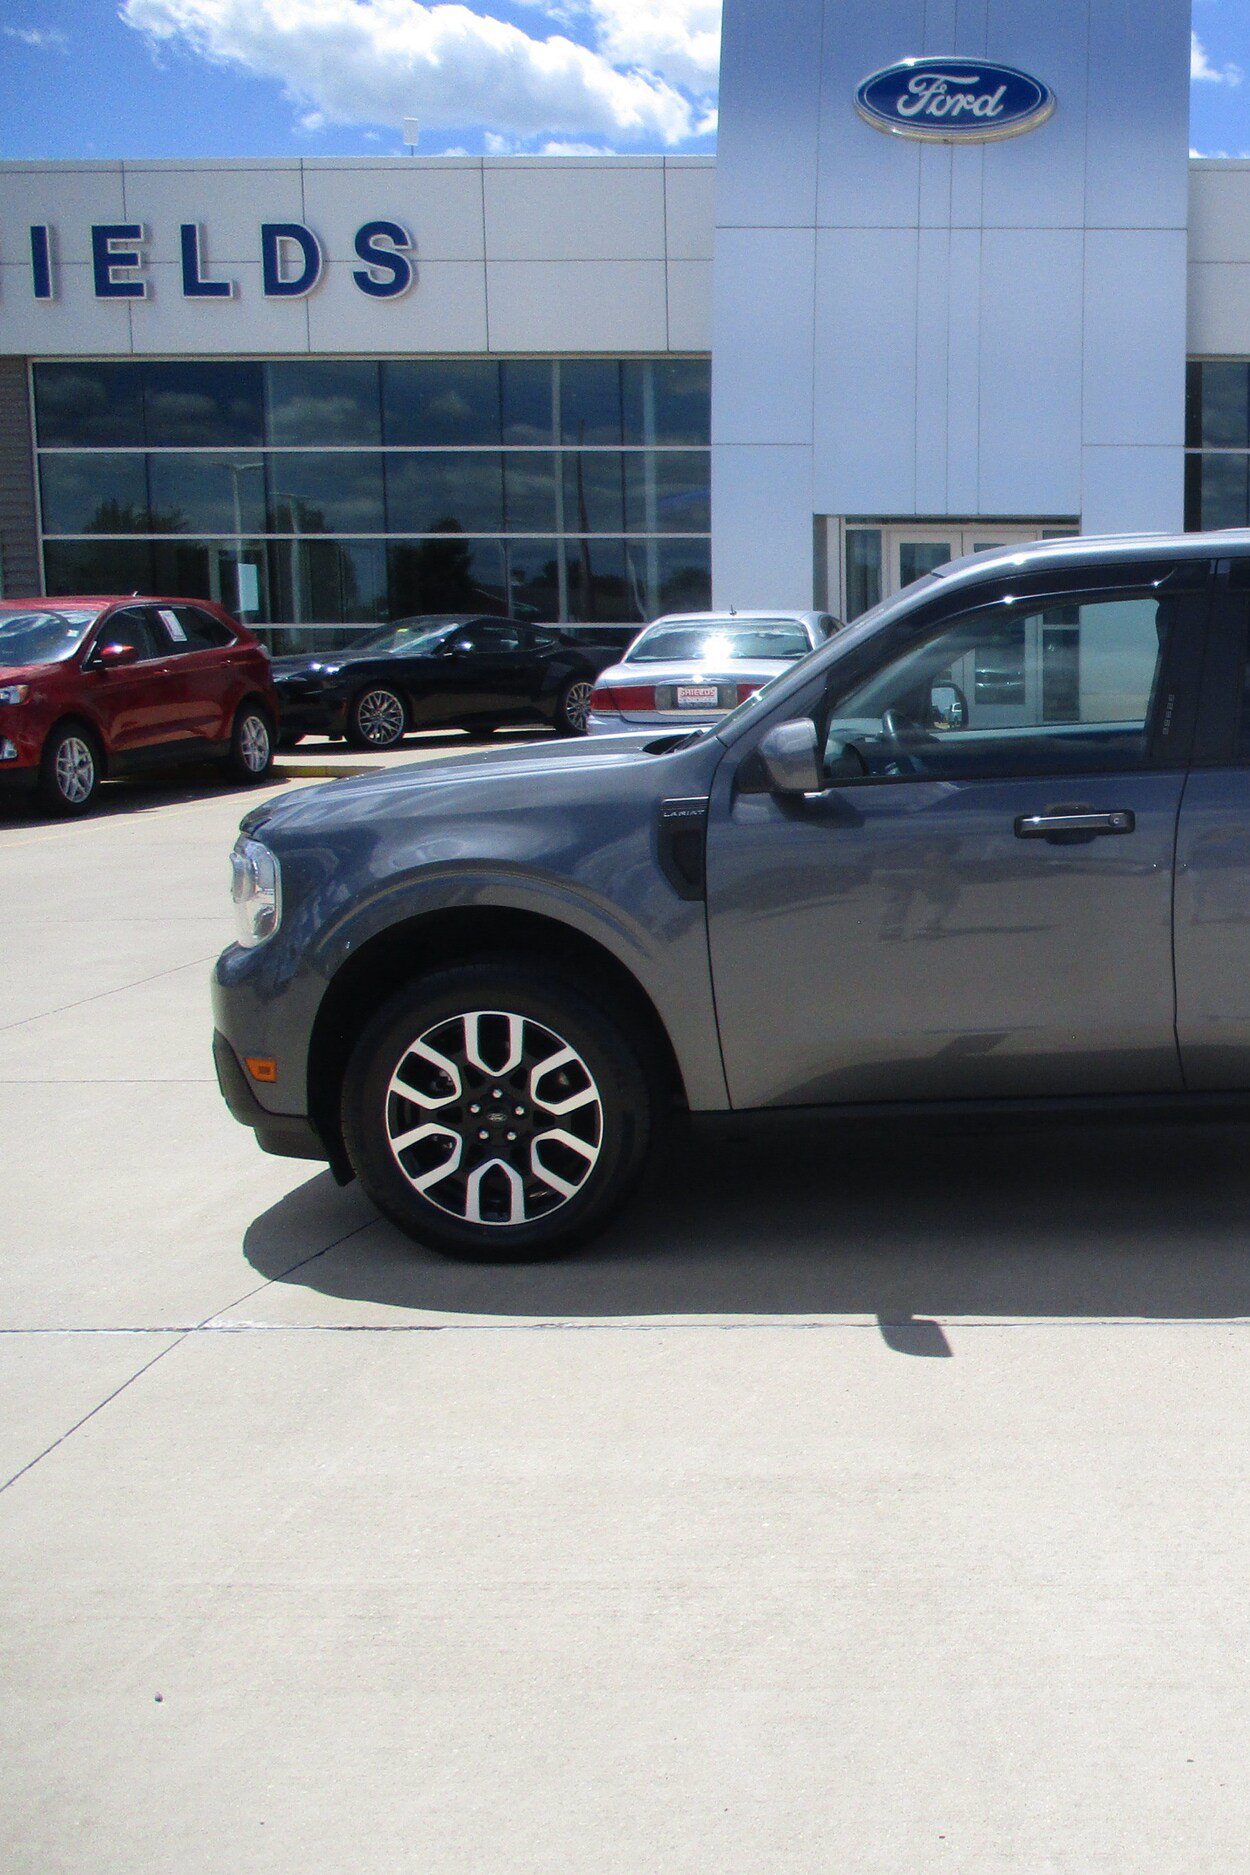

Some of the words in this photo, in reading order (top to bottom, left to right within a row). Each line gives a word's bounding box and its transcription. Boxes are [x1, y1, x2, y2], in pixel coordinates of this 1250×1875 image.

[897, 73, 1007, 117] Ford
[30, 220, 416, 300] IELDS
[663, 809, 705, 818] LARIAT
